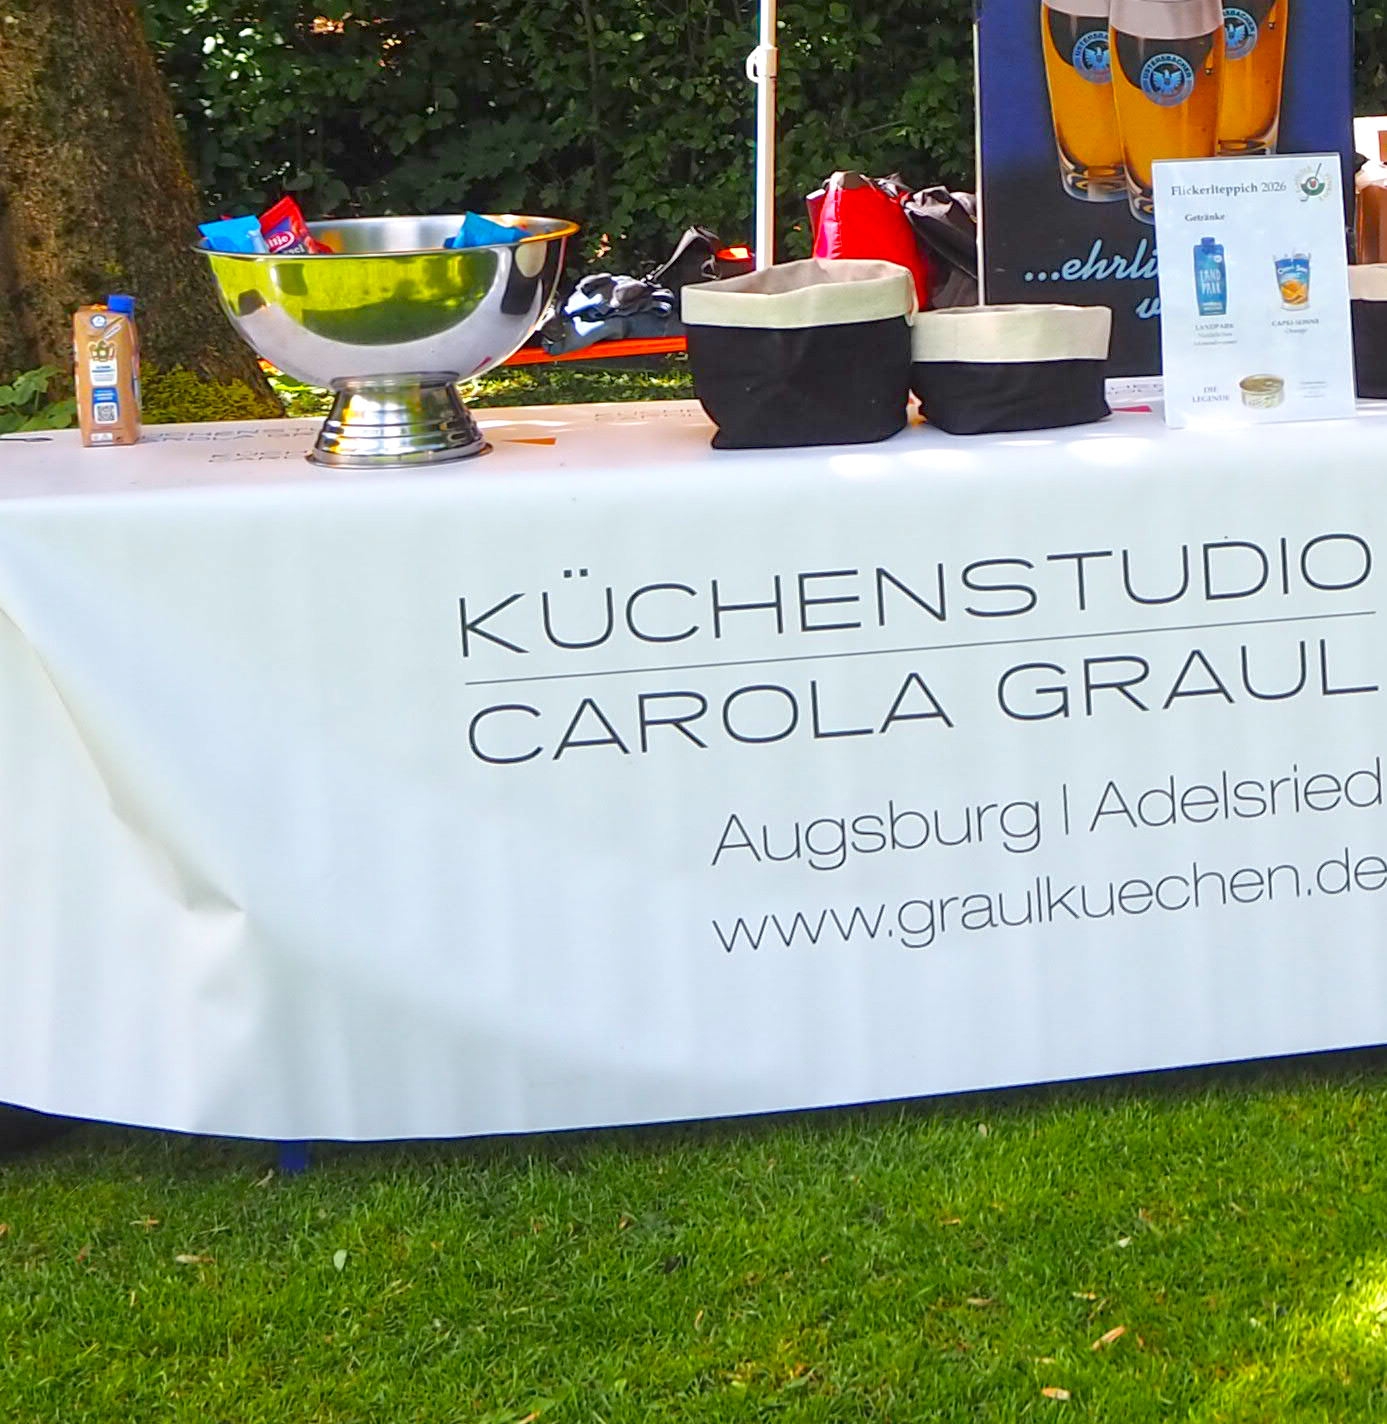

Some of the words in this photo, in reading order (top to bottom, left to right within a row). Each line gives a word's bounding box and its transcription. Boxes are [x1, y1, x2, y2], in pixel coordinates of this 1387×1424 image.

[1170, 182, 1258, 197] Flickerlteppich
[1261, 181, 1287, 193] 2026
[1024, 238, 1158, 281] ...ehrli
[458, 532, 1372, 658] KÜCHENSTUDIO
[466, 671, 954, 766] CAROLA
[996, 636, 1380, 722] GRAUL
[711, 792, 1042, 871] Augsburg
[1088, 757, 1384, 832] Adelsried
